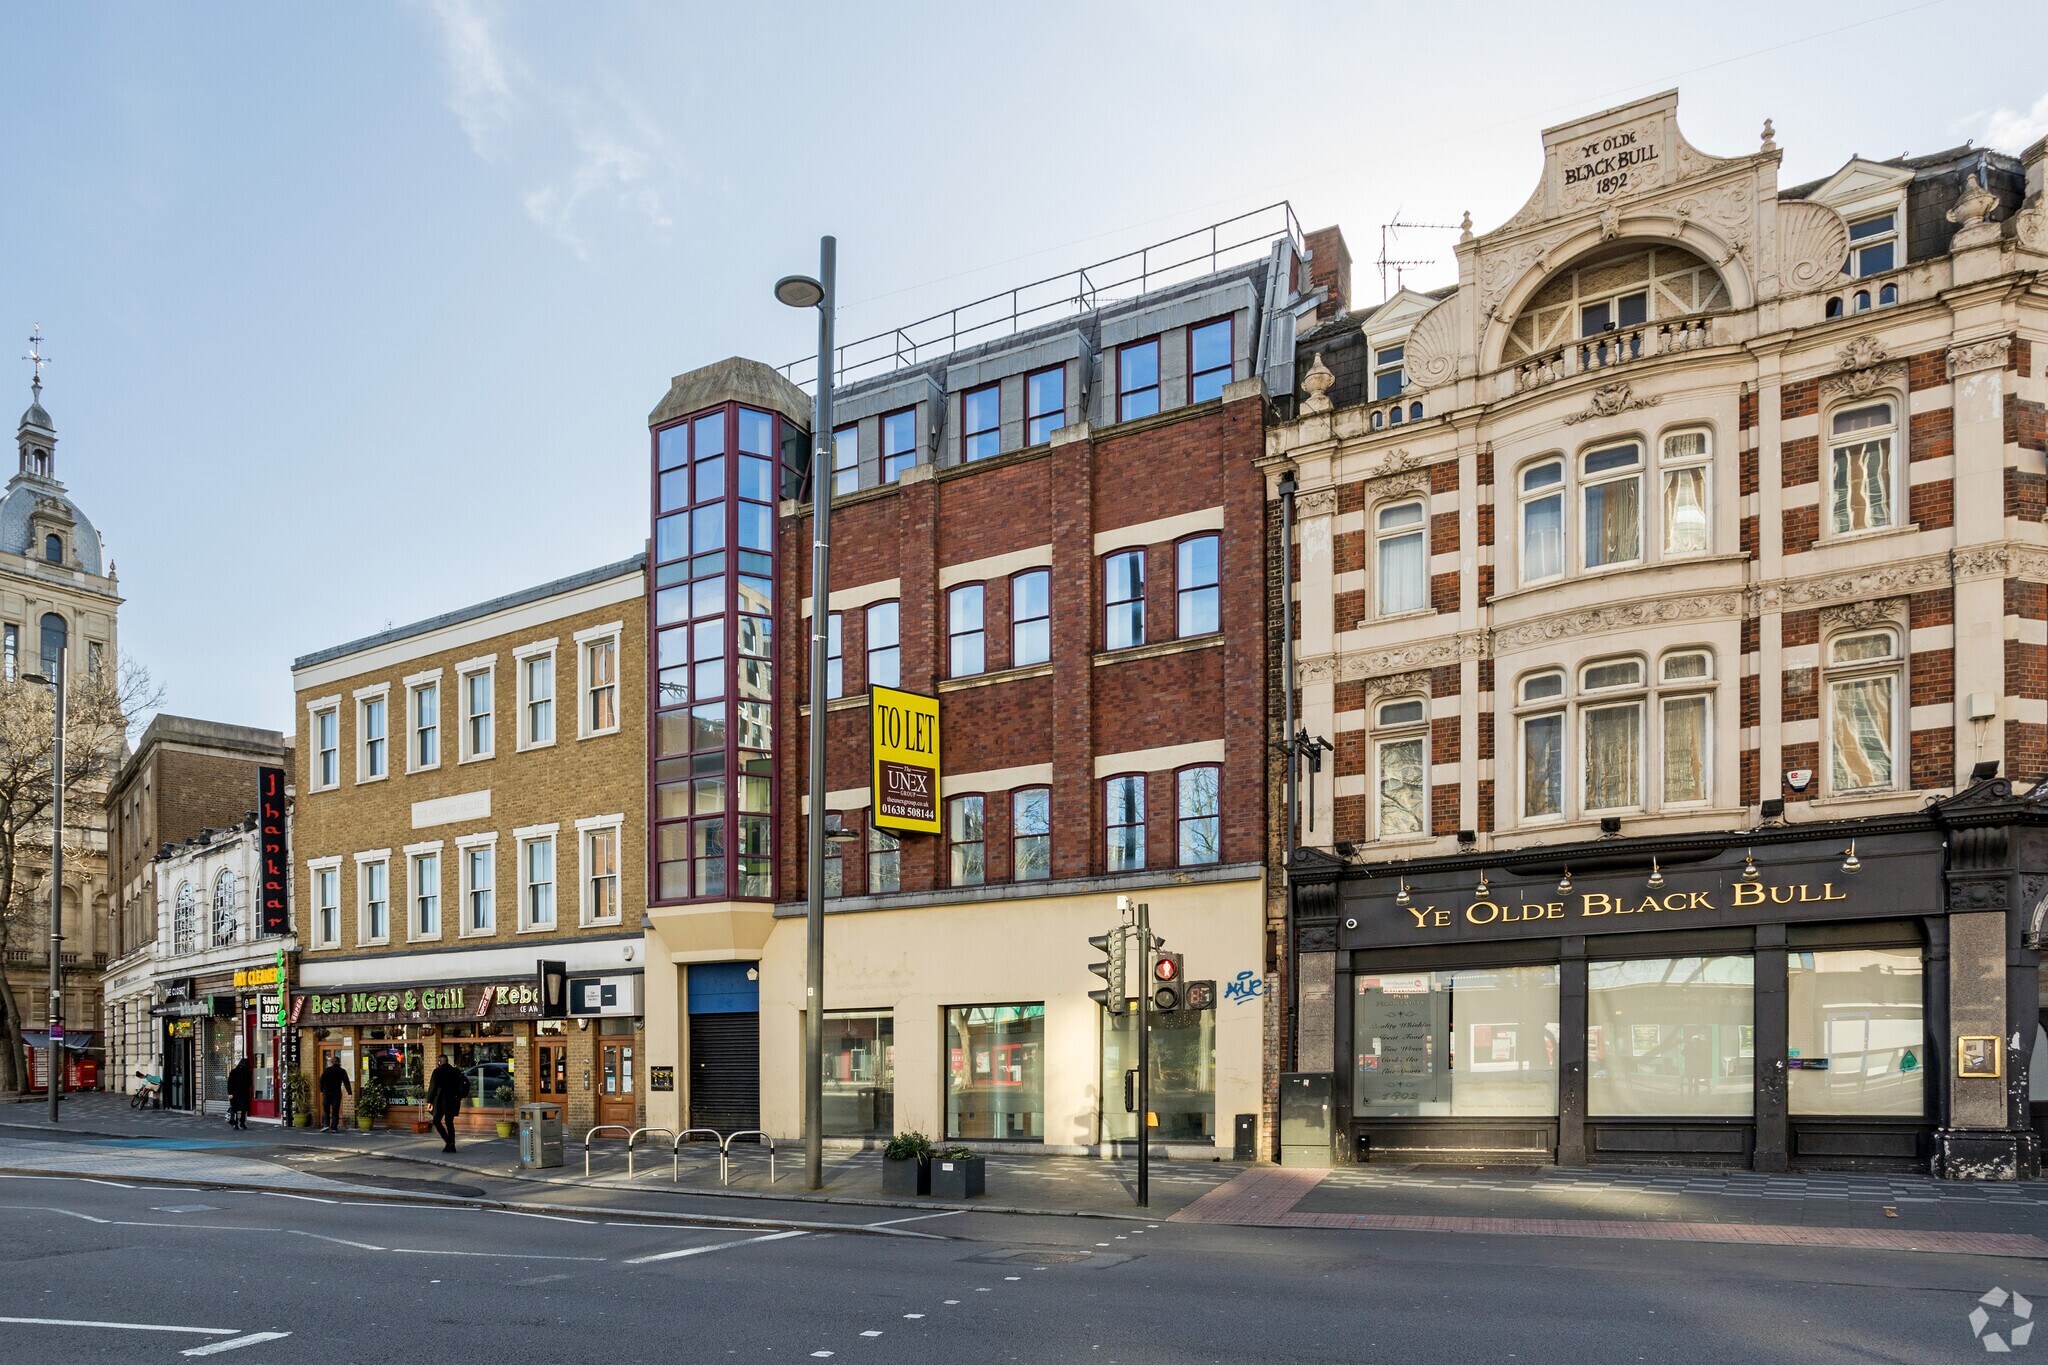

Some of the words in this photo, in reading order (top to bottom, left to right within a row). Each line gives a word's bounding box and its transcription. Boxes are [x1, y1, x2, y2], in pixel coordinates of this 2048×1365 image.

[1582, 143, 1599, 158] YE
[1603, 131, 1637, 151] OLDE
[1564, 156, 1616, 185] BLACK
[1618, 144, 1659, 170] BULL
[1596, 172, 1628, 195] 1892
[878, 704, 901, 749] TO
[904, 709, 936, 755] LET
[888, 770, 928, 794] UNEX
[900, 790, 917, 798] GROUP
[882, 803, 906, 816] 01638
[907, 807, 934, 819] 508144
[264, 773, 285, 928] Jhankaar
[234, 971, 247, 987] DRY
[264, 1005, 279, 1013] DAY
[311, 994, 347, 1014] Best
[351, 993, 399, 1013] Meze
[404, 990, 417, 1011] &
[422, 988, 465, 1010] Grill
[1382, 1091, 1419, 1101] 1892
